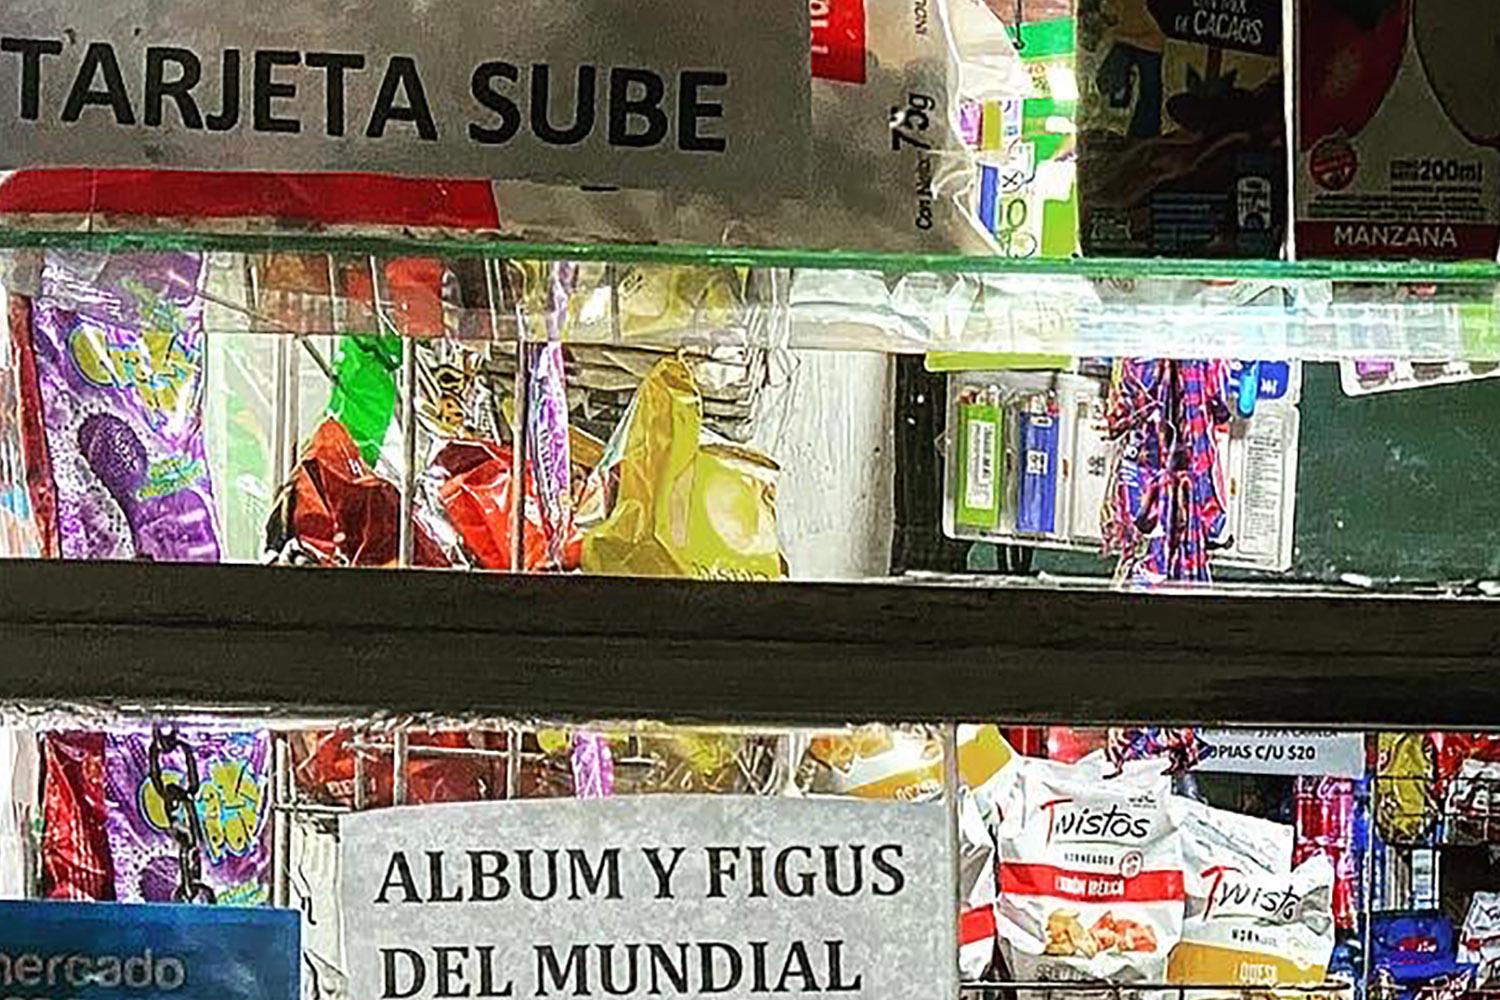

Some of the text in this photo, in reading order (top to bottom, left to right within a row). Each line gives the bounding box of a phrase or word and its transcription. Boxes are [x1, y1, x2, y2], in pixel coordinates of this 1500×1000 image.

[1193, 9, 1264, 45] CACAOS
[0, 38, 728, 152] TARJETA SUBE
[889, 92, 936, 151] 75g
[1334, 226, 1458, 248] MANZANA
[1210, 744, 1252, 760] OPIAS
[1256, 744, 1284, 761] C/U
[1040, 798, 1151, 848] Twistos
[373, 844, 906, 904] ALBUM Y FIGUS
[380, 940, 862, 1000] DEL MUNDIAL
